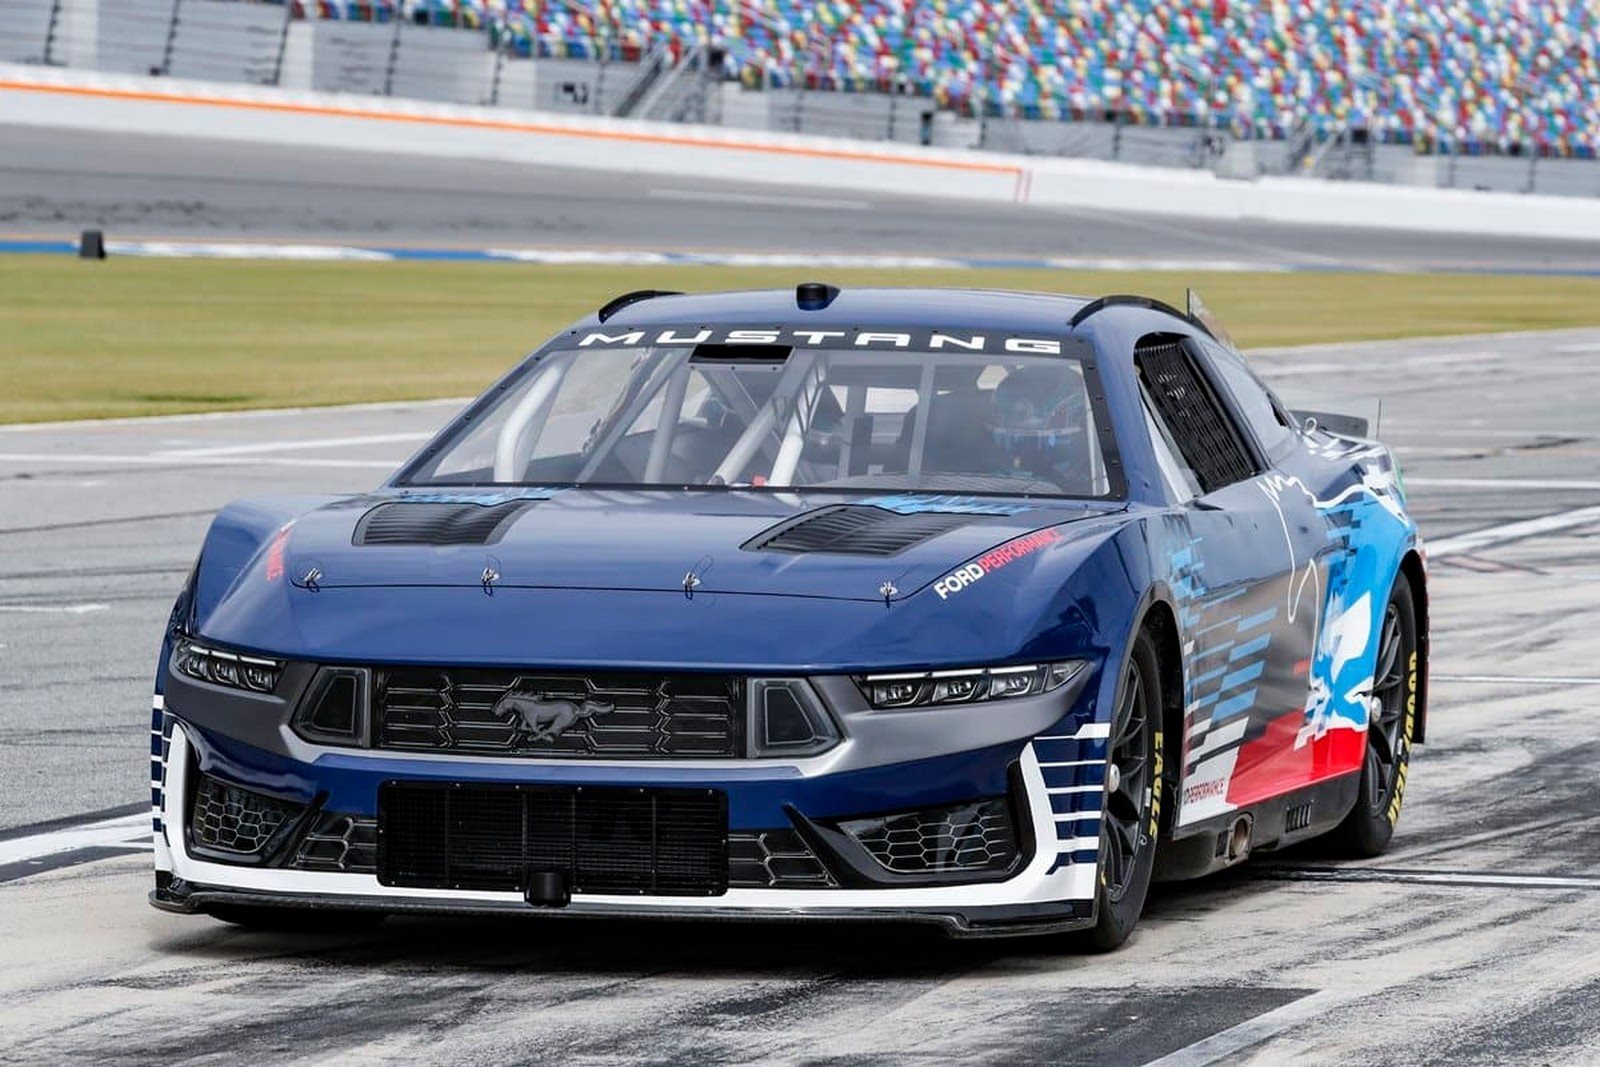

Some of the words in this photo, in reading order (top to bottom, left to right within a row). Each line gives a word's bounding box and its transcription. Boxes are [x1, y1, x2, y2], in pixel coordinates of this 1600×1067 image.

[578, 329, 1062, 355] MUSTANG
[933, 563, 985, 600] FORD
[1149, 731, 1163, 839] EAGLE
